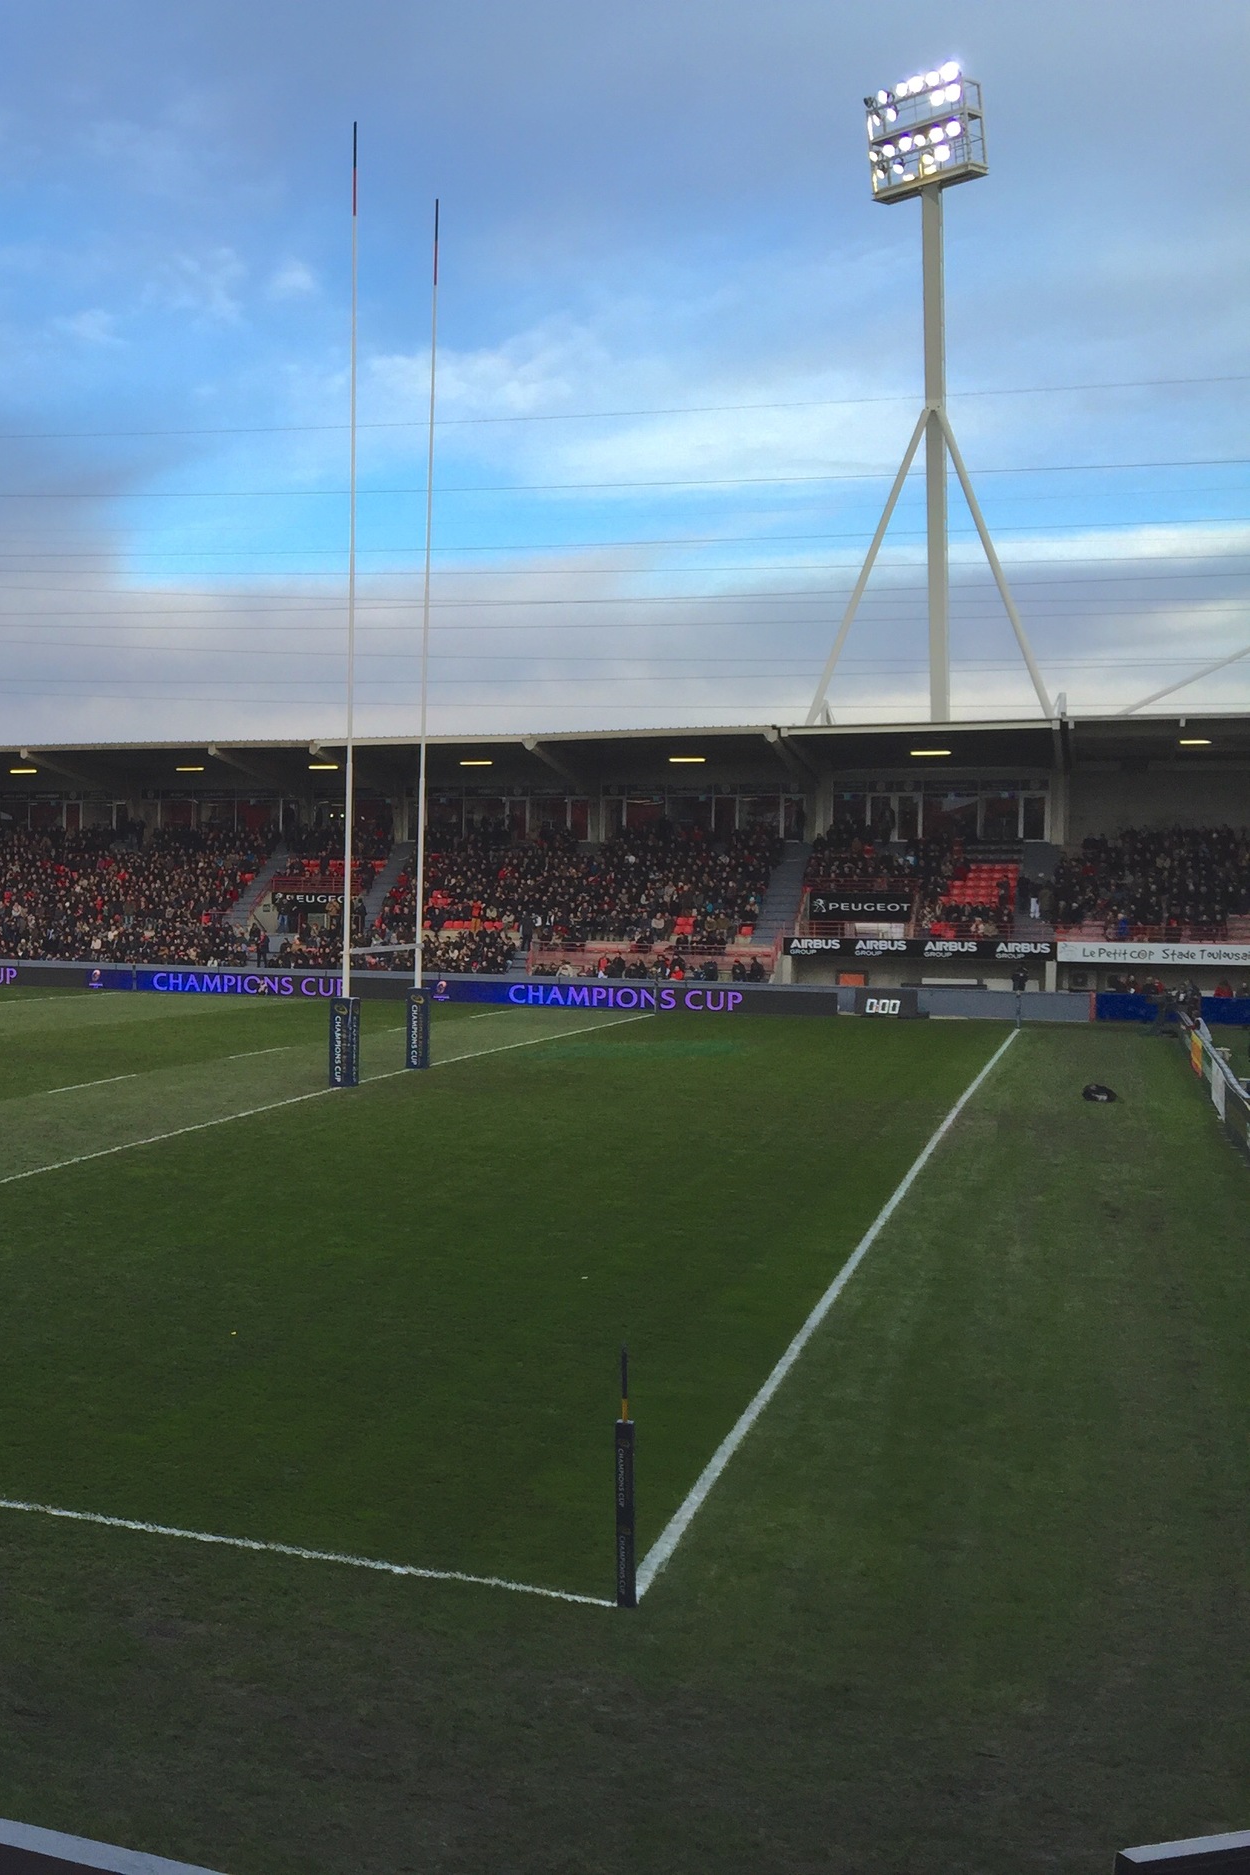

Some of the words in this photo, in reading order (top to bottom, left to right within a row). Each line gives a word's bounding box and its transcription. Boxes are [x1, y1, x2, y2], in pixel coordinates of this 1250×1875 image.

[829, 902, 911, 912] PEUGEOT
[790, 938, 841, 949] AIRBUS
[855, 940, 907, 951] AIRBUS
[924, 941, 978, 952] AIRBUS
[996, 942, 1051, 953] AIRBUS
[1082, 948, 1096, 958] Le
[1098, 948, 1128, 960] Petit
[1162, 949, 1196, 961] Stade
[152, 972, 294, 995] CHAMPIONS
[508, 984, 676, 1010] CHAMPIONS
[684, 989, 743, 1012] CUP
[334, 1015, 342, 1063] CHAMPIONS
[334, 1065, 342, 1083] CUP
